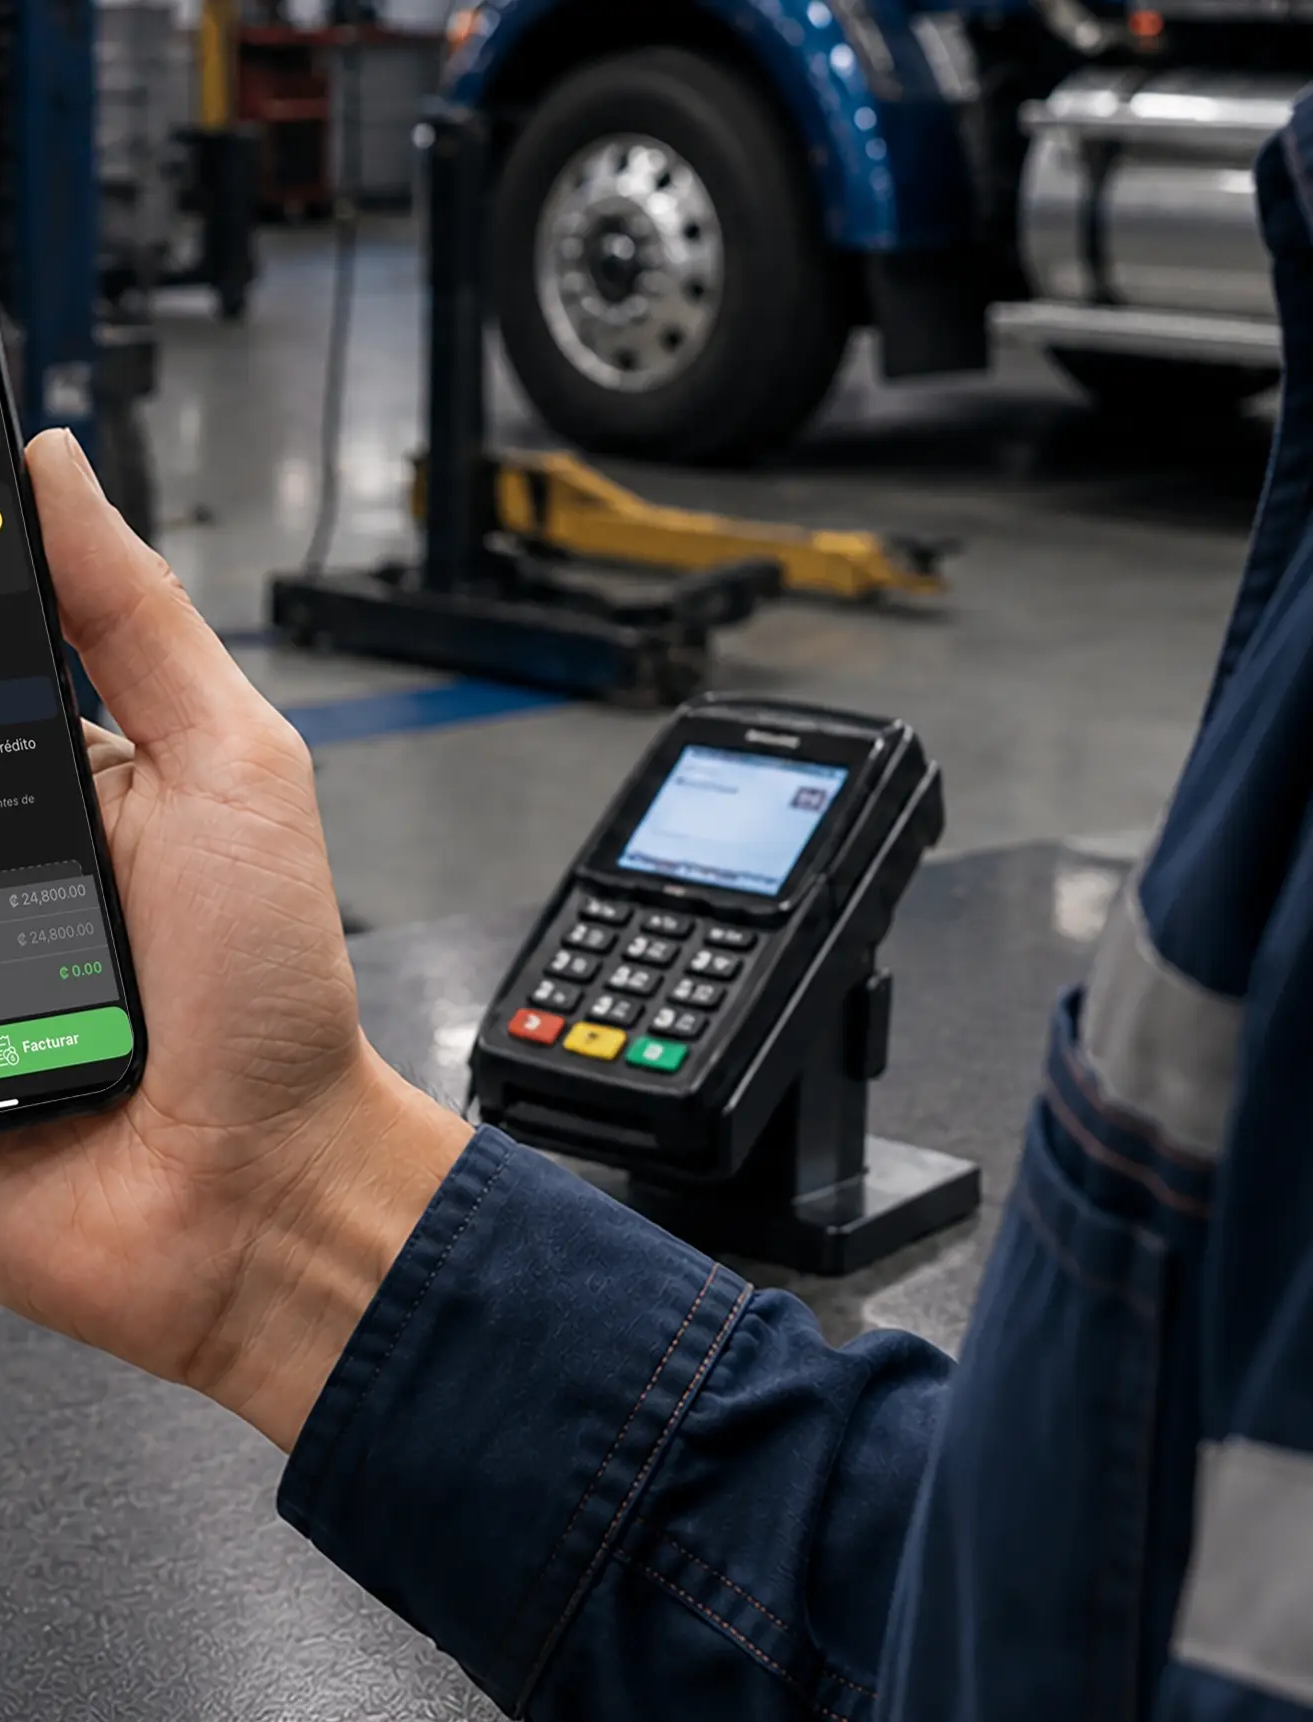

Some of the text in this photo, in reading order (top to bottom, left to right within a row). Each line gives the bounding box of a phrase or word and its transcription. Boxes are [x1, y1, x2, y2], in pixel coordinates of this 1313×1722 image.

[21, 794, 34, 804] de
[21, 884, 86, 905] 24,800.00
[29, 922, 94, 944] 24,800.00
[72, 961, 102, 977] 0.00
[22, 1034, 79, 1053] Facturar
